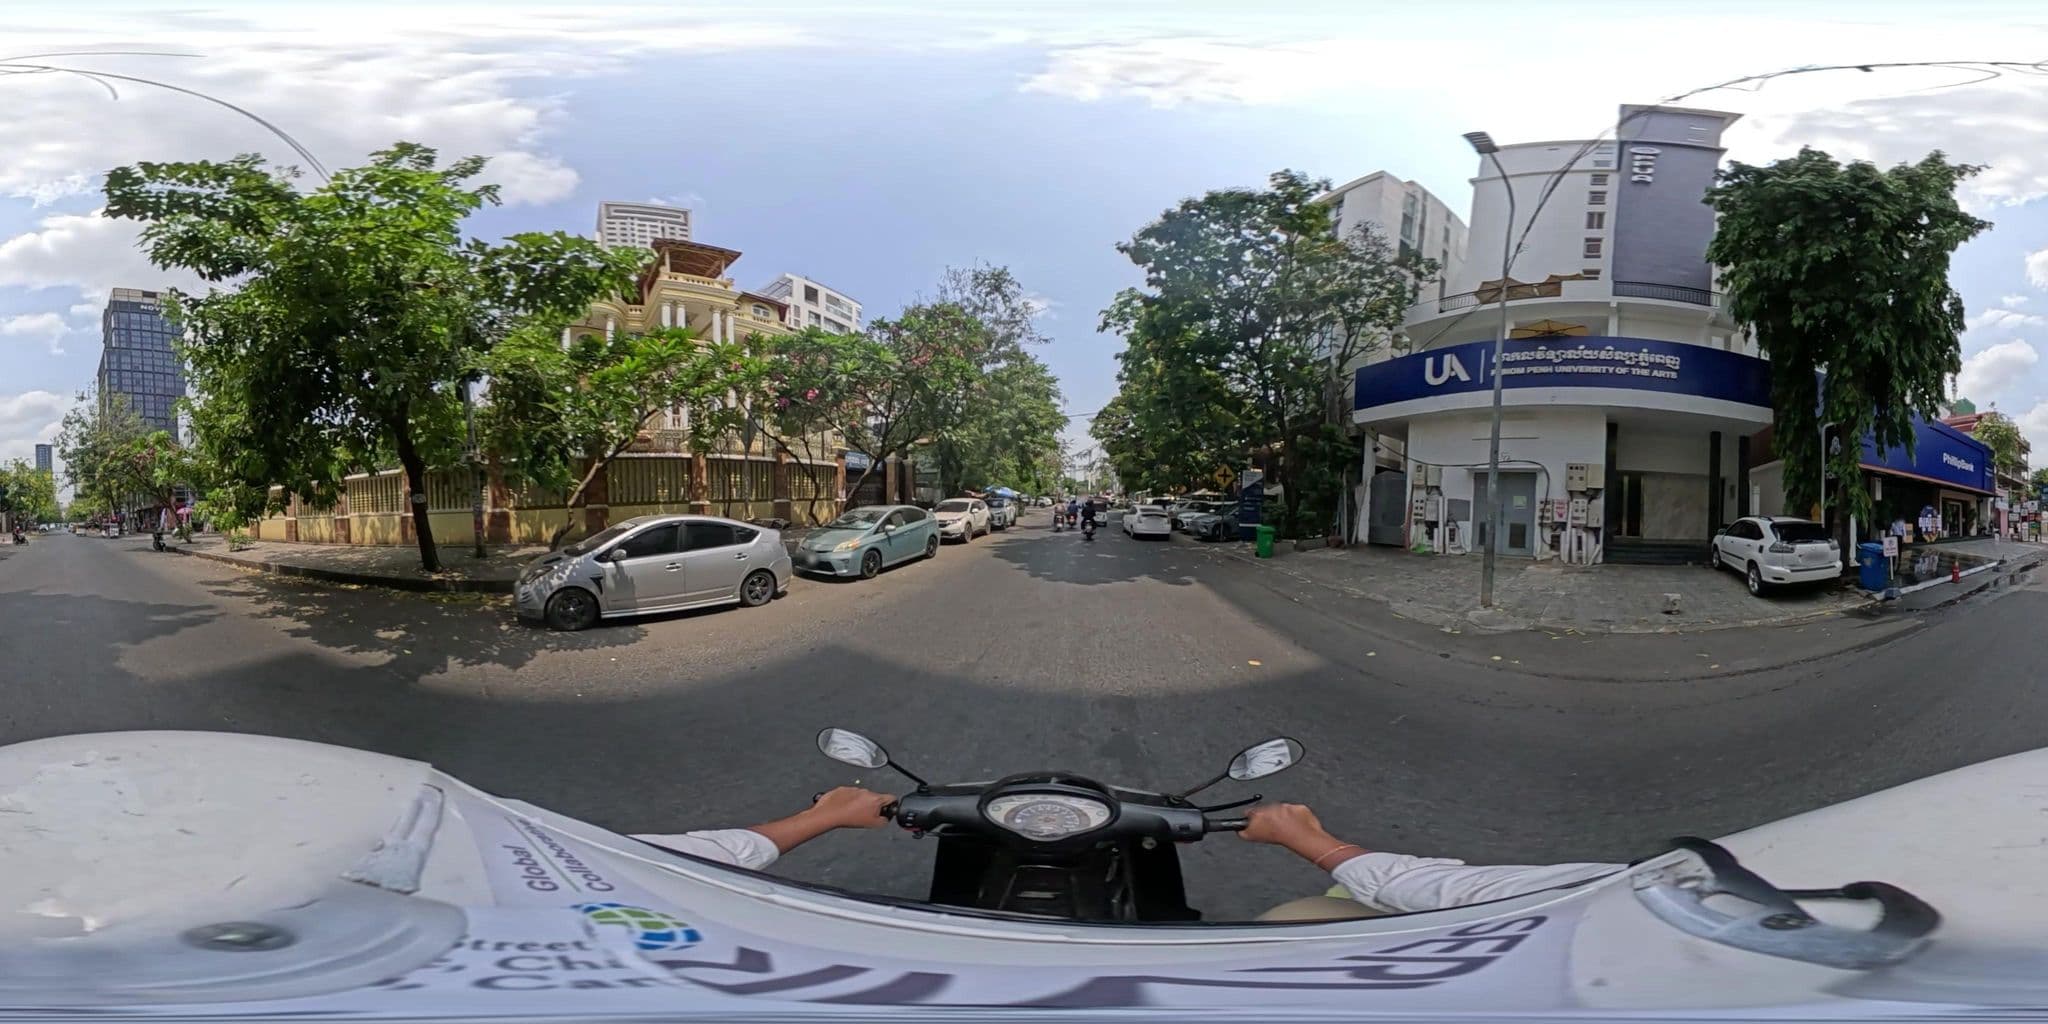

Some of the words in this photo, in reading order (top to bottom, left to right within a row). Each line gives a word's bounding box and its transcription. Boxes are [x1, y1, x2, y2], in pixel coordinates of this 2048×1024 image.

[1425, 354, 1471, 385] UA
[1526, 366, 1553, 374] PENH
[1555, 365, 1615, 374] UNIVERSITY
[1615, 367, 1630, 375] OF
[1631, 368, 1650, 376] THE
[1651, 369, 1678, 379] ARTS
[501, 845, 559, 891] Global
